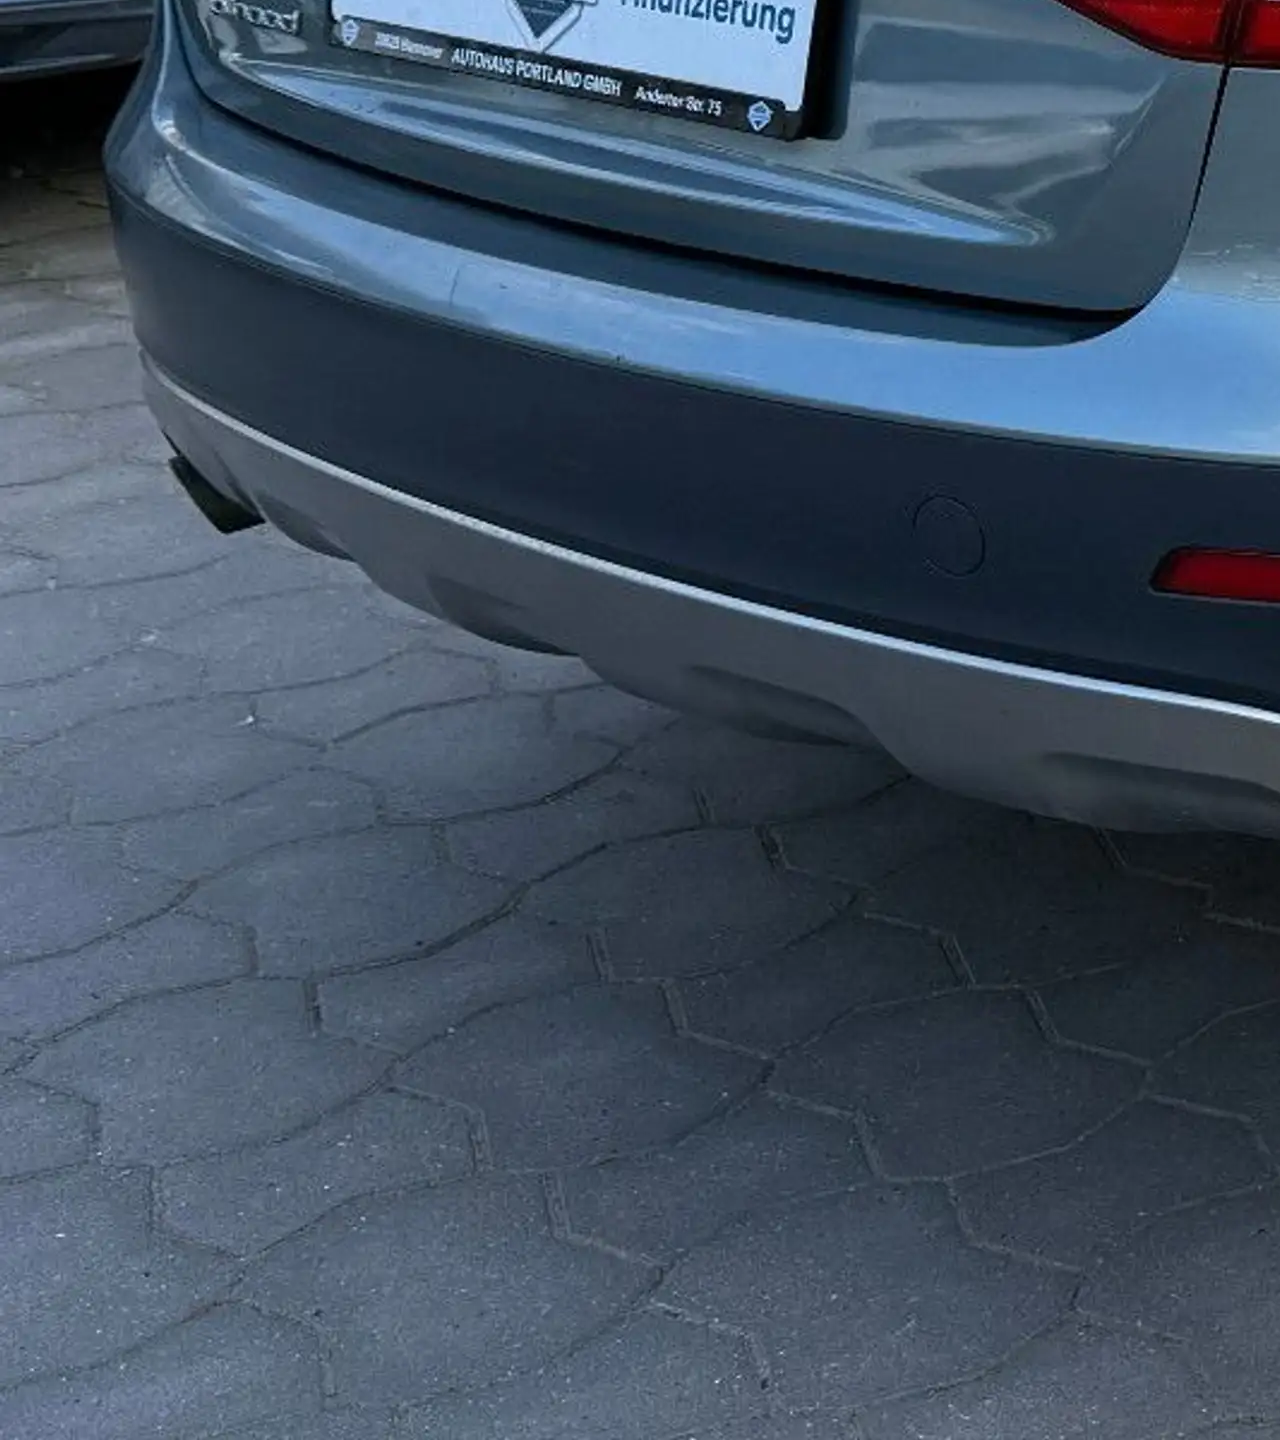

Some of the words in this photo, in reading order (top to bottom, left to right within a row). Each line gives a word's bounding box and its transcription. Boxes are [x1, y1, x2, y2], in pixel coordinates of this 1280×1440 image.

[450, 48, 515, 76] AUTOHAUS
[515, 60, 582, 90] PORTLAND
[583, 73, 623, 98] GMBH
[707, 98, 723, 117] 75
